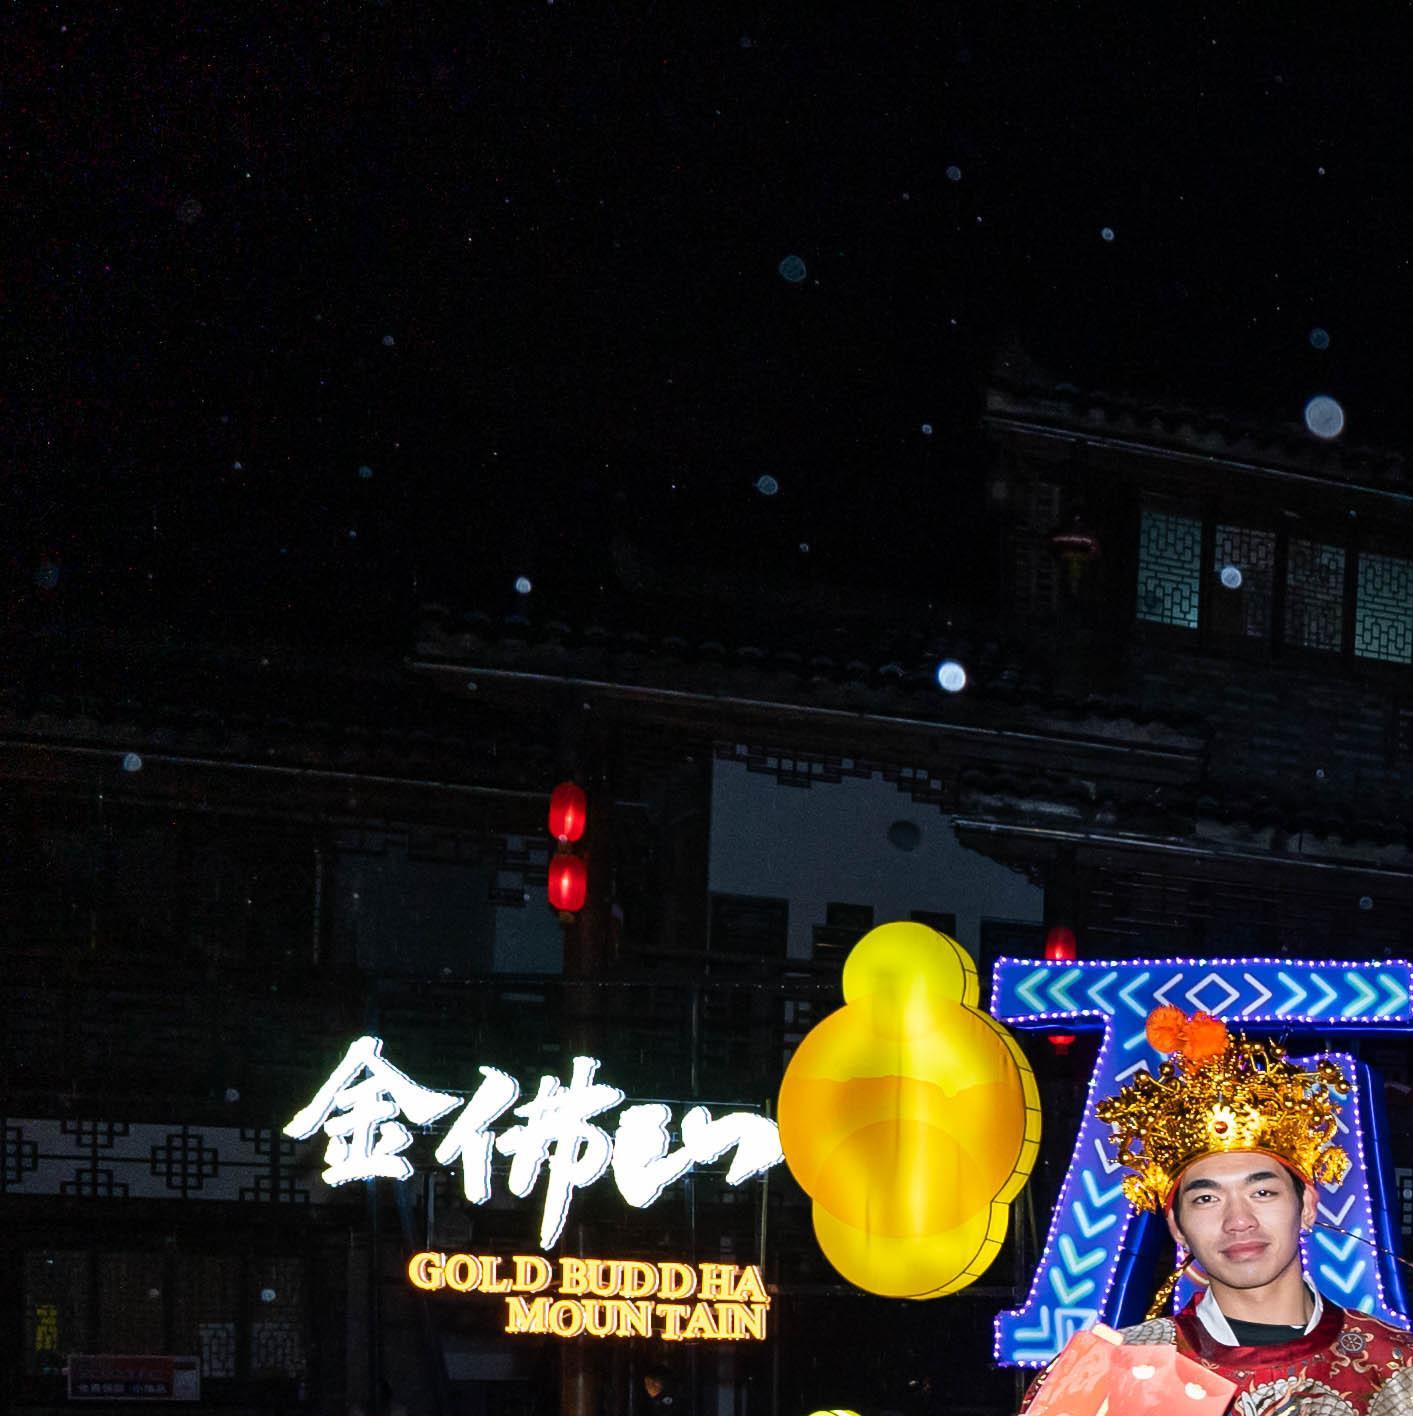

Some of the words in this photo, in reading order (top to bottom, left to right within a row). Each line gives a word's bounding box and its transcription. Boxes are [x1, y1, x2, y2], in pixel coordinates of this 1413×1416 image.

[283, 1036, 784, 1250] 金佛山
[409, 1252, 552, 1293] GOLD
[558, 1257, 771, 1302] BUDDHA
[505, 1296, 771, 1341] MOUNTAIN
